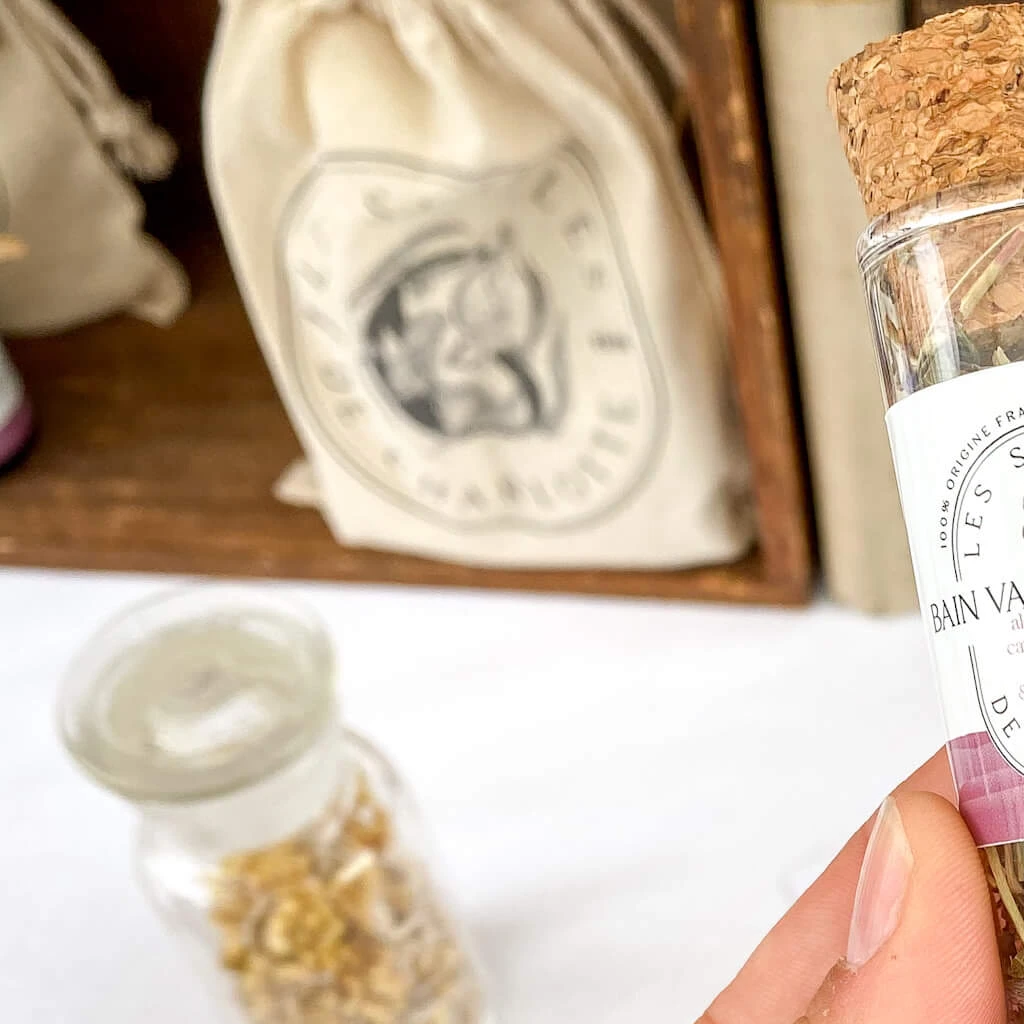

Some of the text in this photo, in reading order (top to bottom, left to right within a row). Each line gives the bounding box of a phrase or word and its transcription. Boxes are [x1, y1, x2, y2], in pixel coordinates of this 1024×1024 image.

[945, 424, 991, 490] ORIGINE
[963, 483, 993, 558] LES
[930, 591, 980, 632] BAIN
[991, 695, 1021, 738] DE
